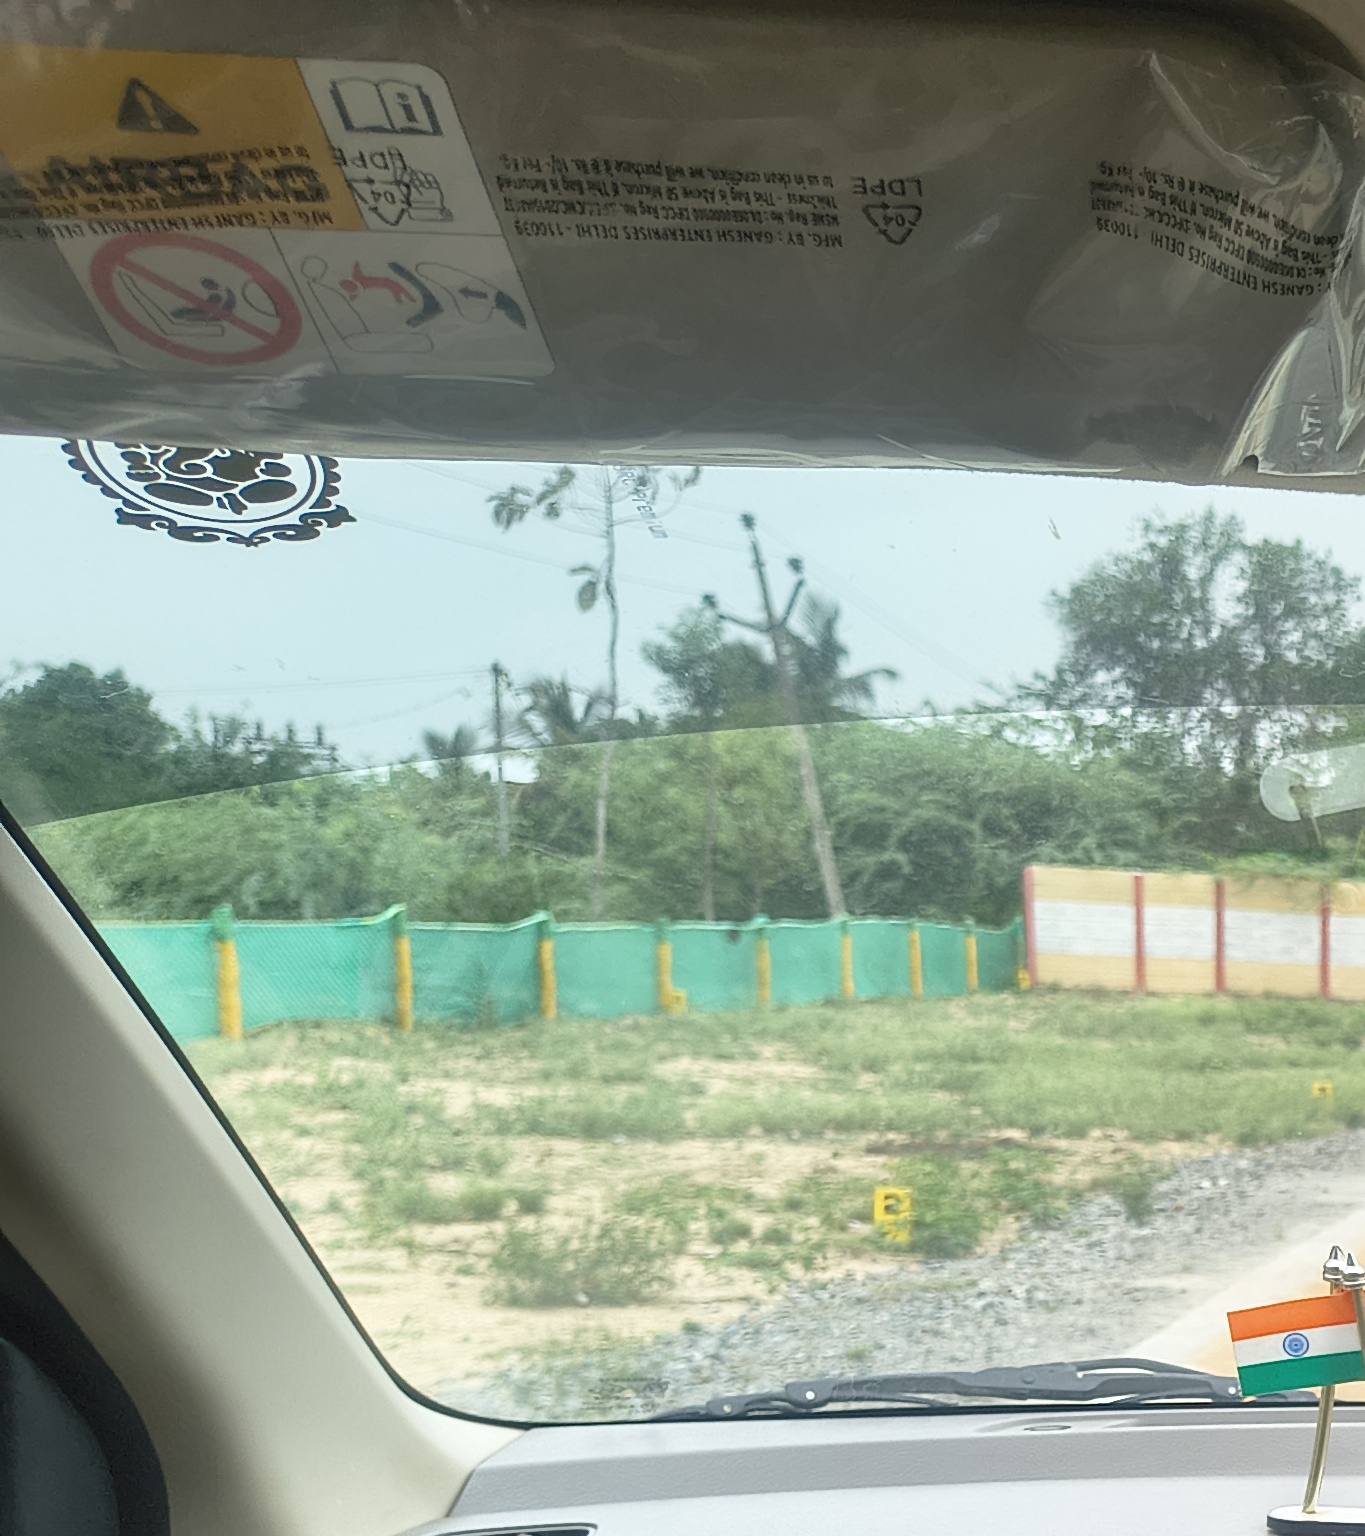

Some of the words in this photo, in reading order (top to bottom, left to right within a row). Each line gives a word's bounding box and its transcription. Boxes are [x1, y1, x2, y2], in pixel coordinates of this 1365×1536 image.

[850, 176, 923, 198] LDPE
[575, 223, 619, 241] DELHI
[621, 225, 713, 243] ENTERPRISES
[716, 228, 774, 245] GANESH
[1150, 230, 1186, 258] DELHI
[1188, 245, 1258, 291] ENTERPRISES
[1261, 278, 1315, 297] GANESH
